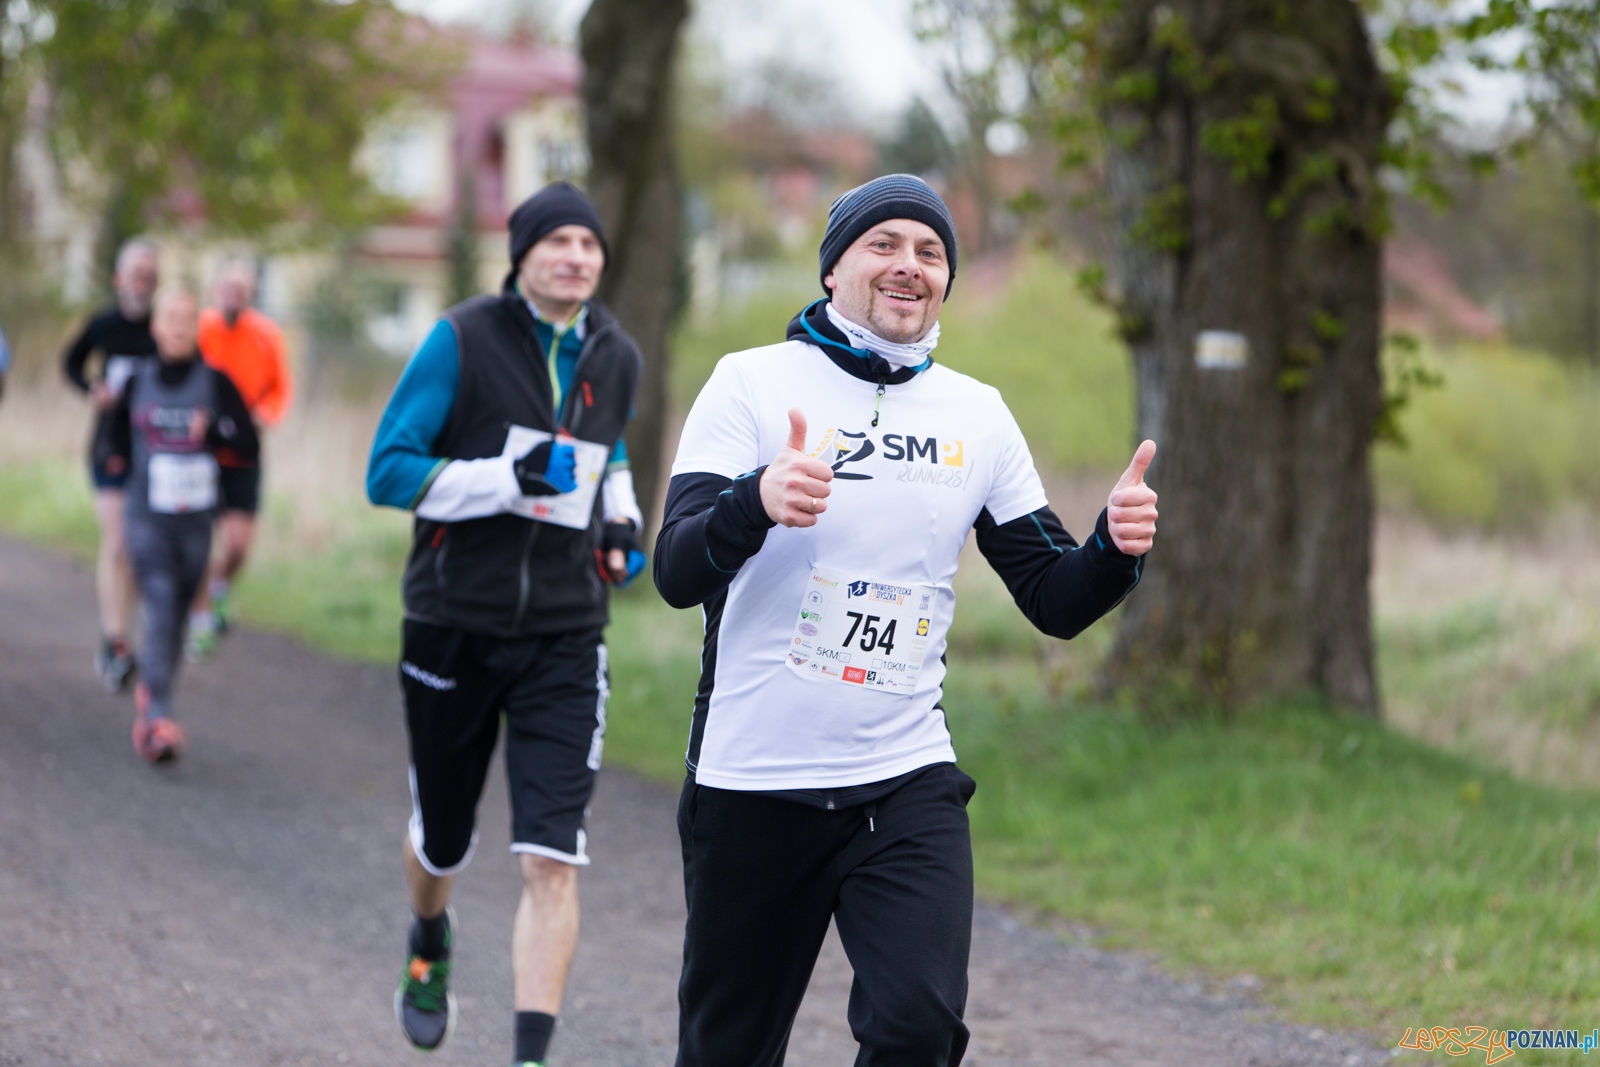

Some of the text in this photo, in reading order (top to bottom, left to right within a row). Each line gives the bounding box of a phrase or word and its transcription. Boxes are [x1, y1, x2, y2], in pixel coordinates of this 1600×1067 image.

[882, 433, 964, 467] SMP
[870, 582, 912, 597] UNIWERSYTECKA
[842, 610, 898, 656] 754
[816, 646, 839, 660] 5KM
[883, 660, 907, 672] 10KM
